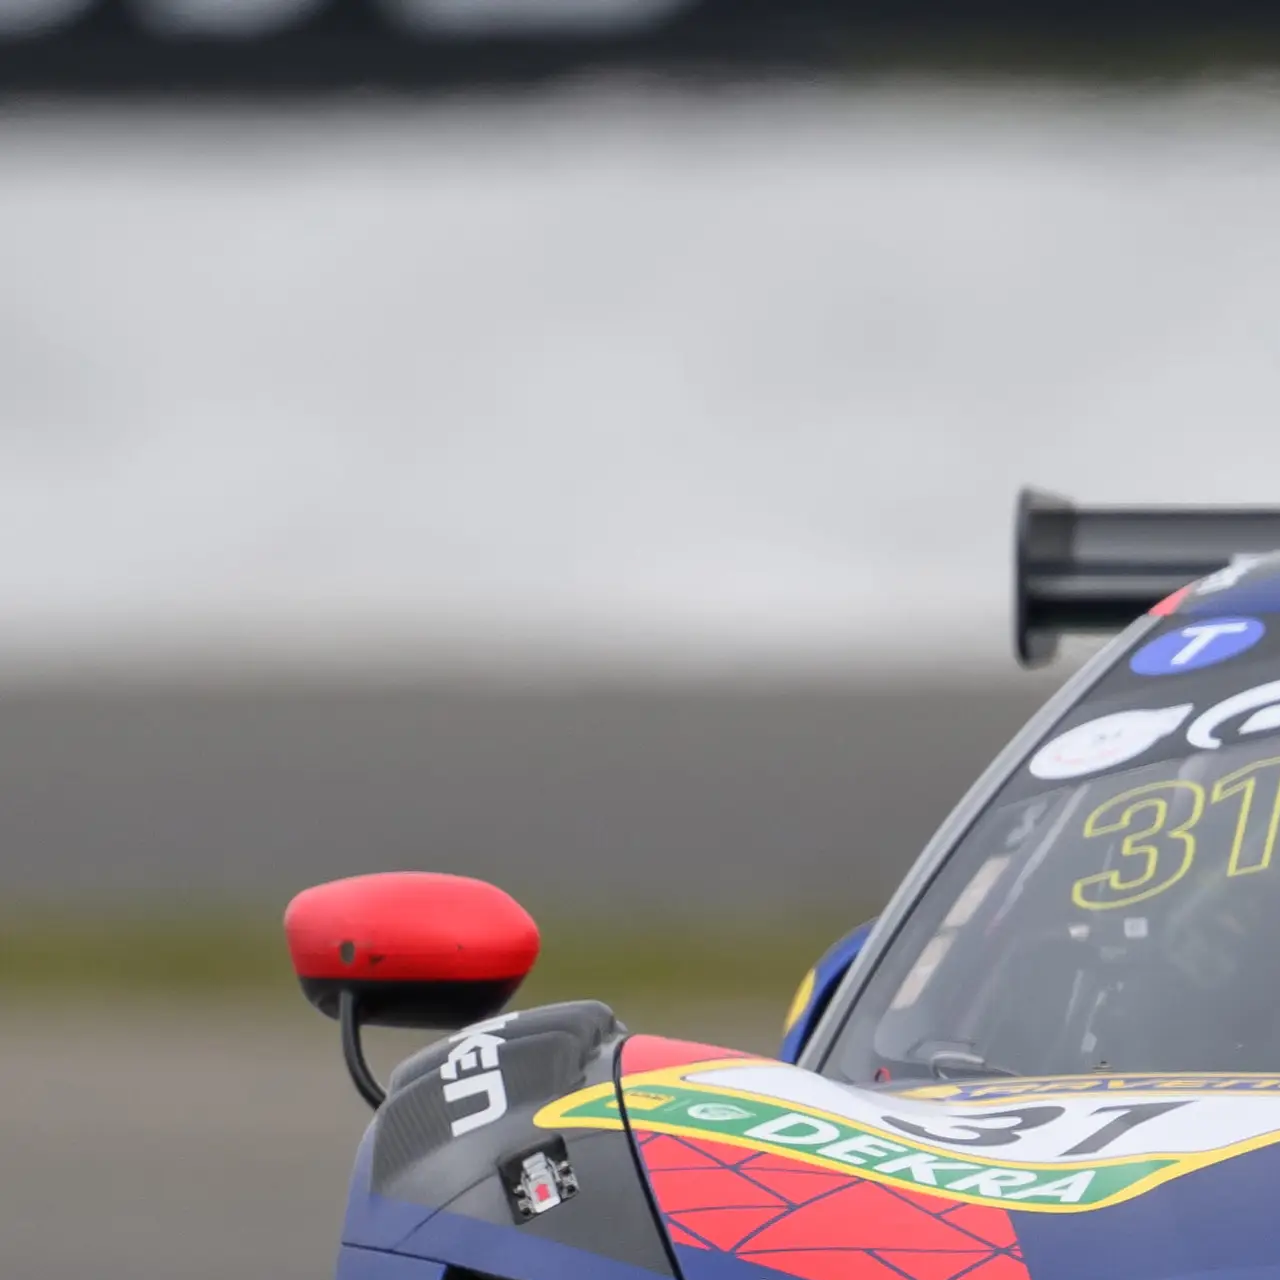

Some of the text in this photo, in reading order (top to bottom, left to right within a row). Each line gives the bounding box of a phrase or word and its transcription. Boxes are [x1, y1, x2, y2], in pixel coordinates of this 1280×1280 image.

[1171, 622, 1248, 666] T
[744, 1113, 1097, 1203] DEKRA
[881, 1100, 1197, 1159] 31
